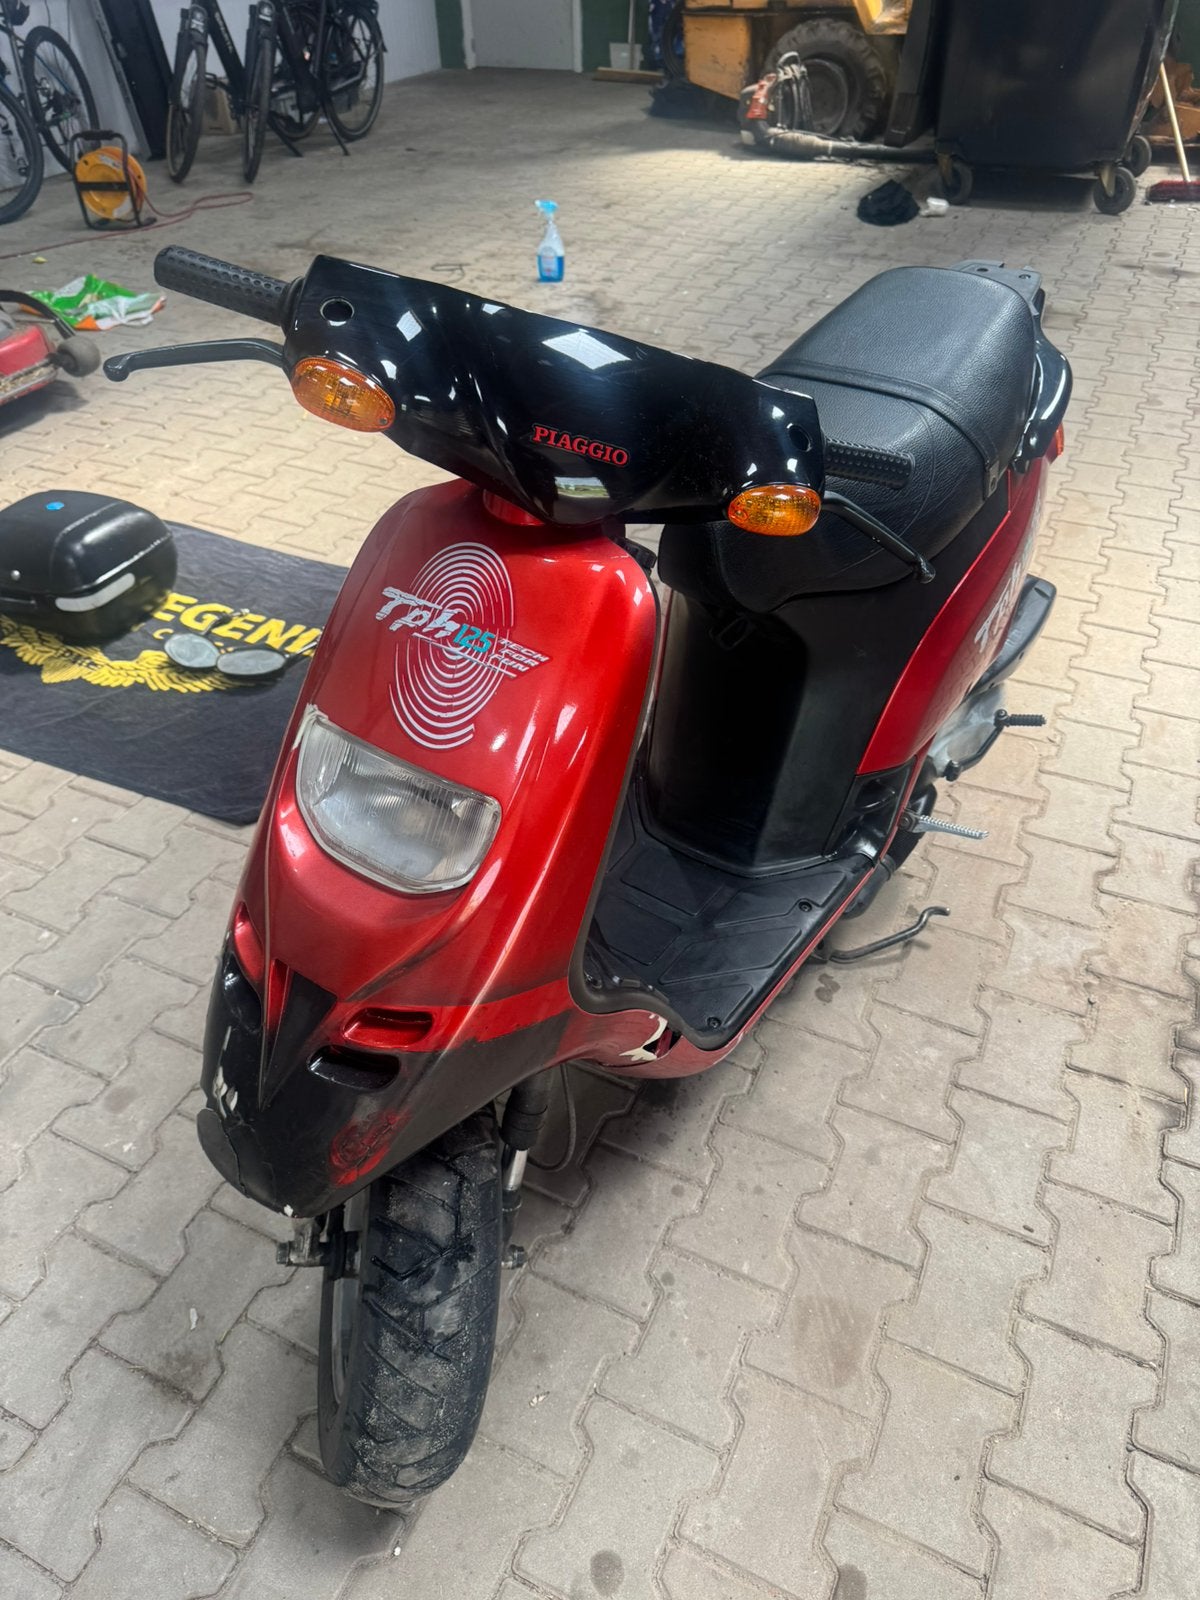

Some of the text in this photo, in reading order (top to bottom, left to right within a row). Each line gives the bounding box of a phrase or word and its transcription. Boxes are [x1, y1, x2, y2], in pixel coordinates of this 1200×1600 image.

[532, 425, 629, 466] PIAGGIO
[453, 623, 496, 653] 125
[499, 638, 550, 662] TECH
[489, 653, 530, 672] FUN
[499, 648, 540, 667] FOR
